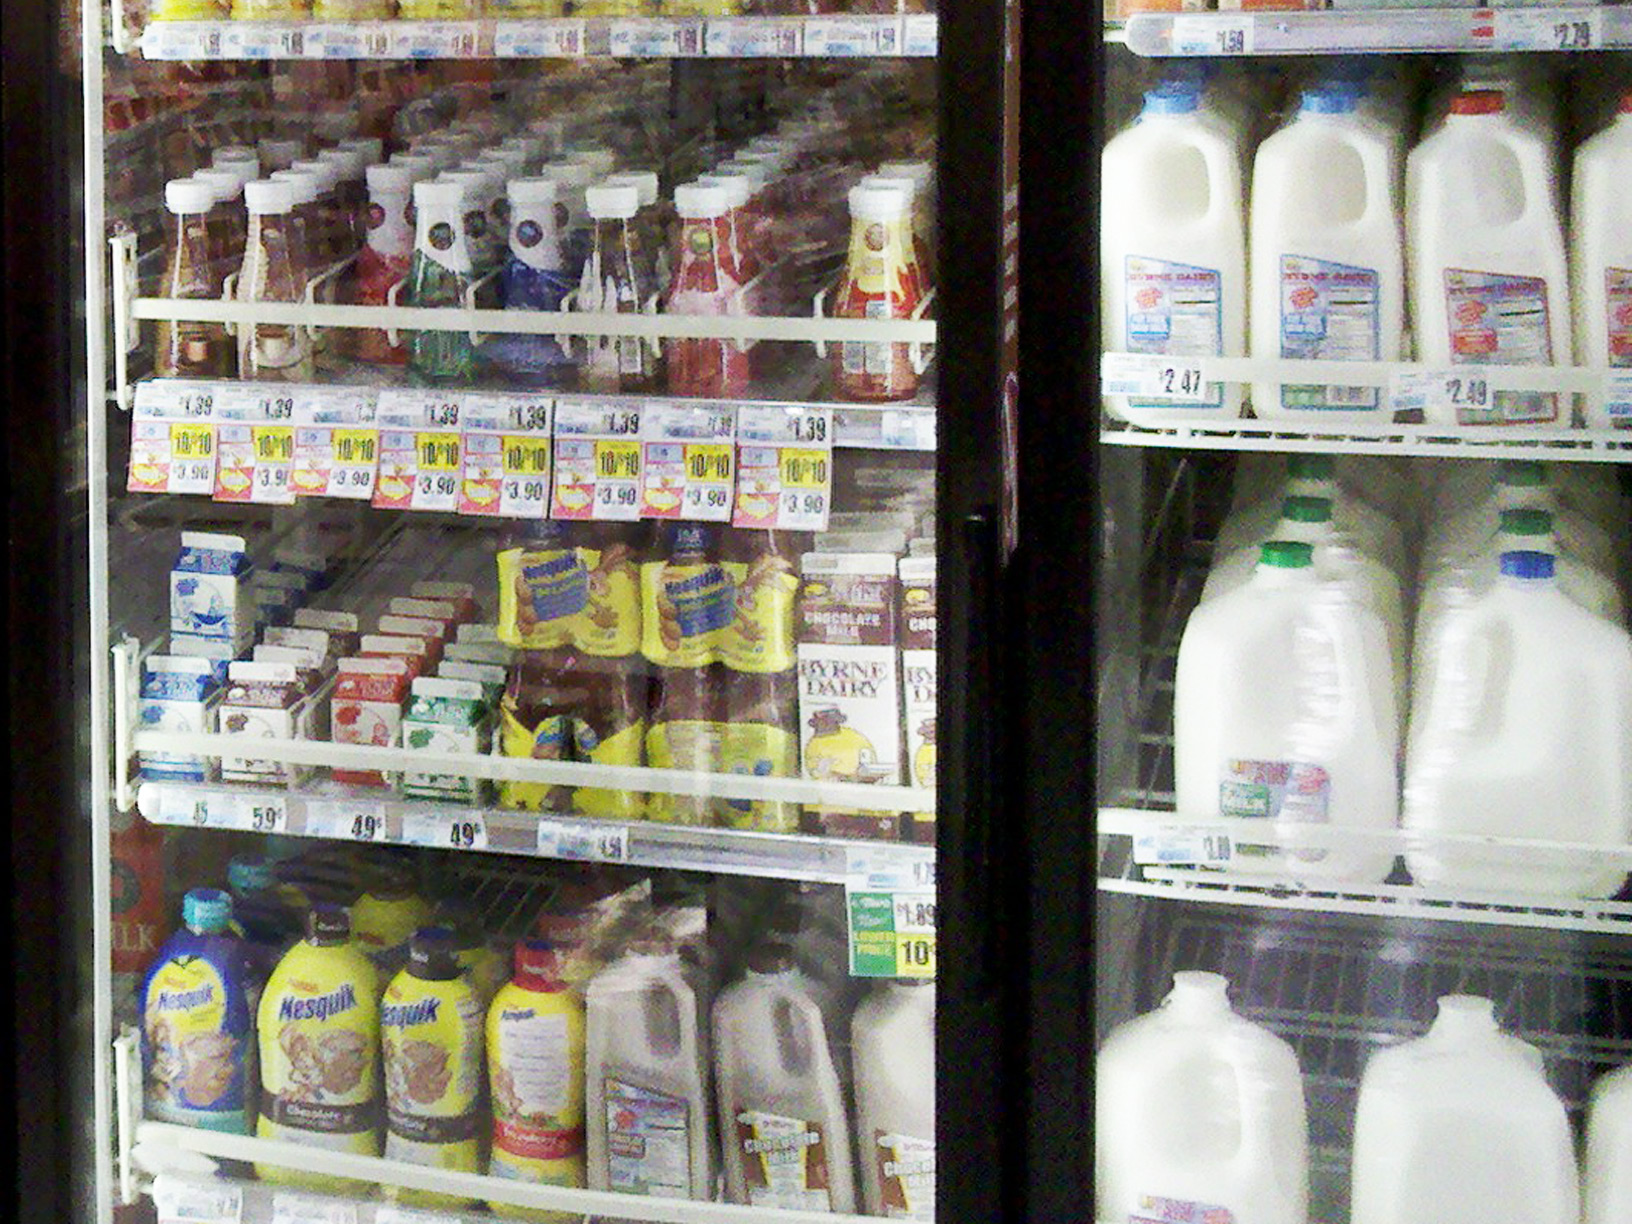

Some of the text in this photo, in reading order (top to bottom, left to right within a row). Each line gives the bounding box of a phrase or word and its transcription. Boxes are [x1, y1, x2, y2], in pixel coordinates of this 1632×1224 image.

[799, 659, 888, 677] BYRNE
[806, 677, 883, 698] DAIRY
[157, 984, 215, 1013] Nesquik
[278, 983, 358, 1023] Nesquik
[380, 997, 441, 1027] esquik
